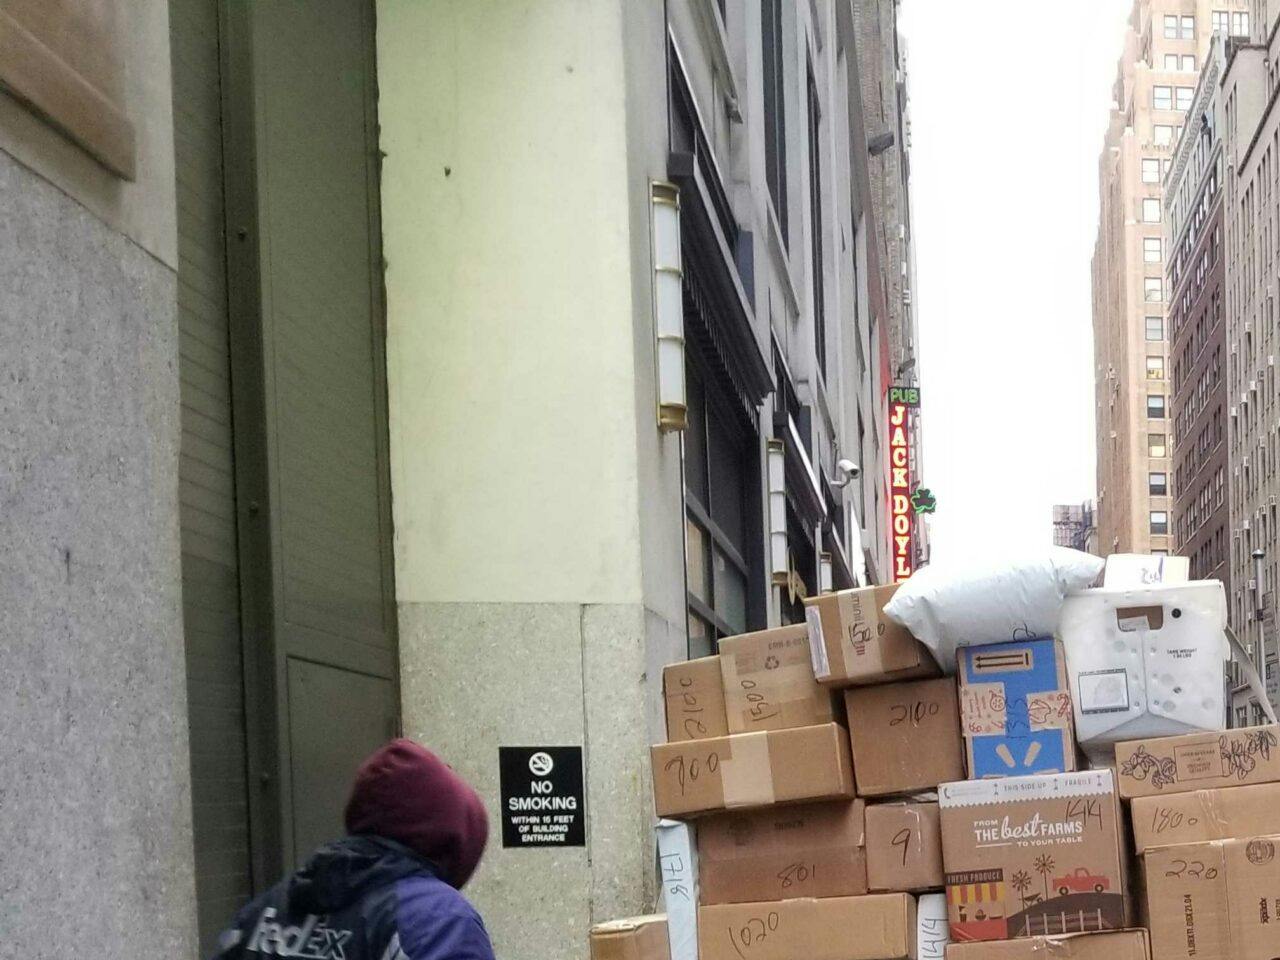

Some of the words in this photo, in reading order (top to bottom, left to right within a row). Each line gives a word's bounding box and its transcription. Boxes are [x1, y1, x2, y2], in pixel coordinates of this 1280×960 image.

[890, 388, 919, 404] PUB
[890, 405, 909, 488] JACK
[892, 494, 911, 583] DOYL
[530, 780, 553, 794] NO
[508, 796, 577, 811] SMOKING
[511, 816, 540, 824] WITHIN
[553, 815, 575, 823] FEET
[973, 819, 999, 828] FROM
[518, 825, 530, 833] OF
[532, 824, 569, 833] BUILDING
[973, 828, 1000, 843] THE
[1000, 813, 1043, 840] best
[1041, 820, 1084, 835] FARMS
[521, 833, 565, 843] ENTRANCE
[1030, 838, 1054, 847] YOUR
[1055, 836, 1083, 844] TABLE
[970, 872, 1002, 882] PRODUCE
